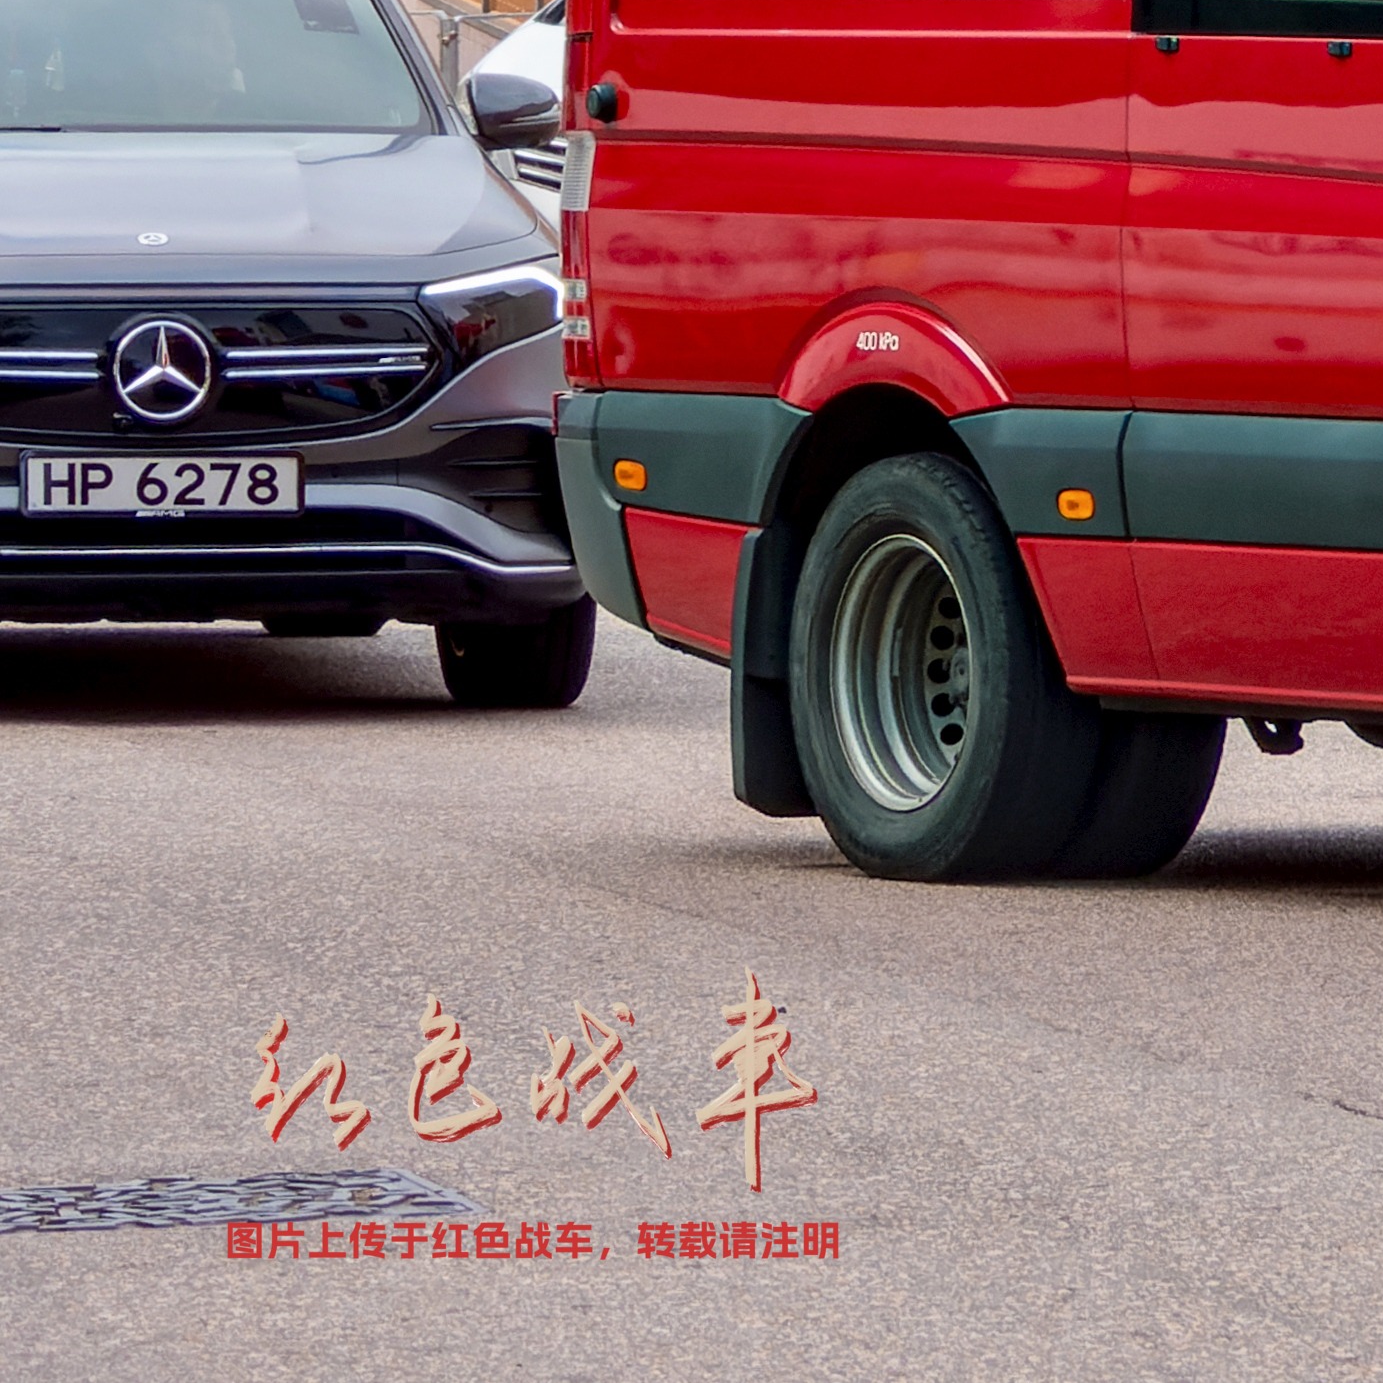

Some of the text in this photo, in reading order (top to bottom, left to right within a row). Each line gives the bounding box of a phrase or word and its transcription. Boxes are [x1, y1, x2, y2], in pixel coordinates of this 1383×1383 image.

[856, 331, 878, 351] 400
[42, 462, 280, 506] HP 6278
